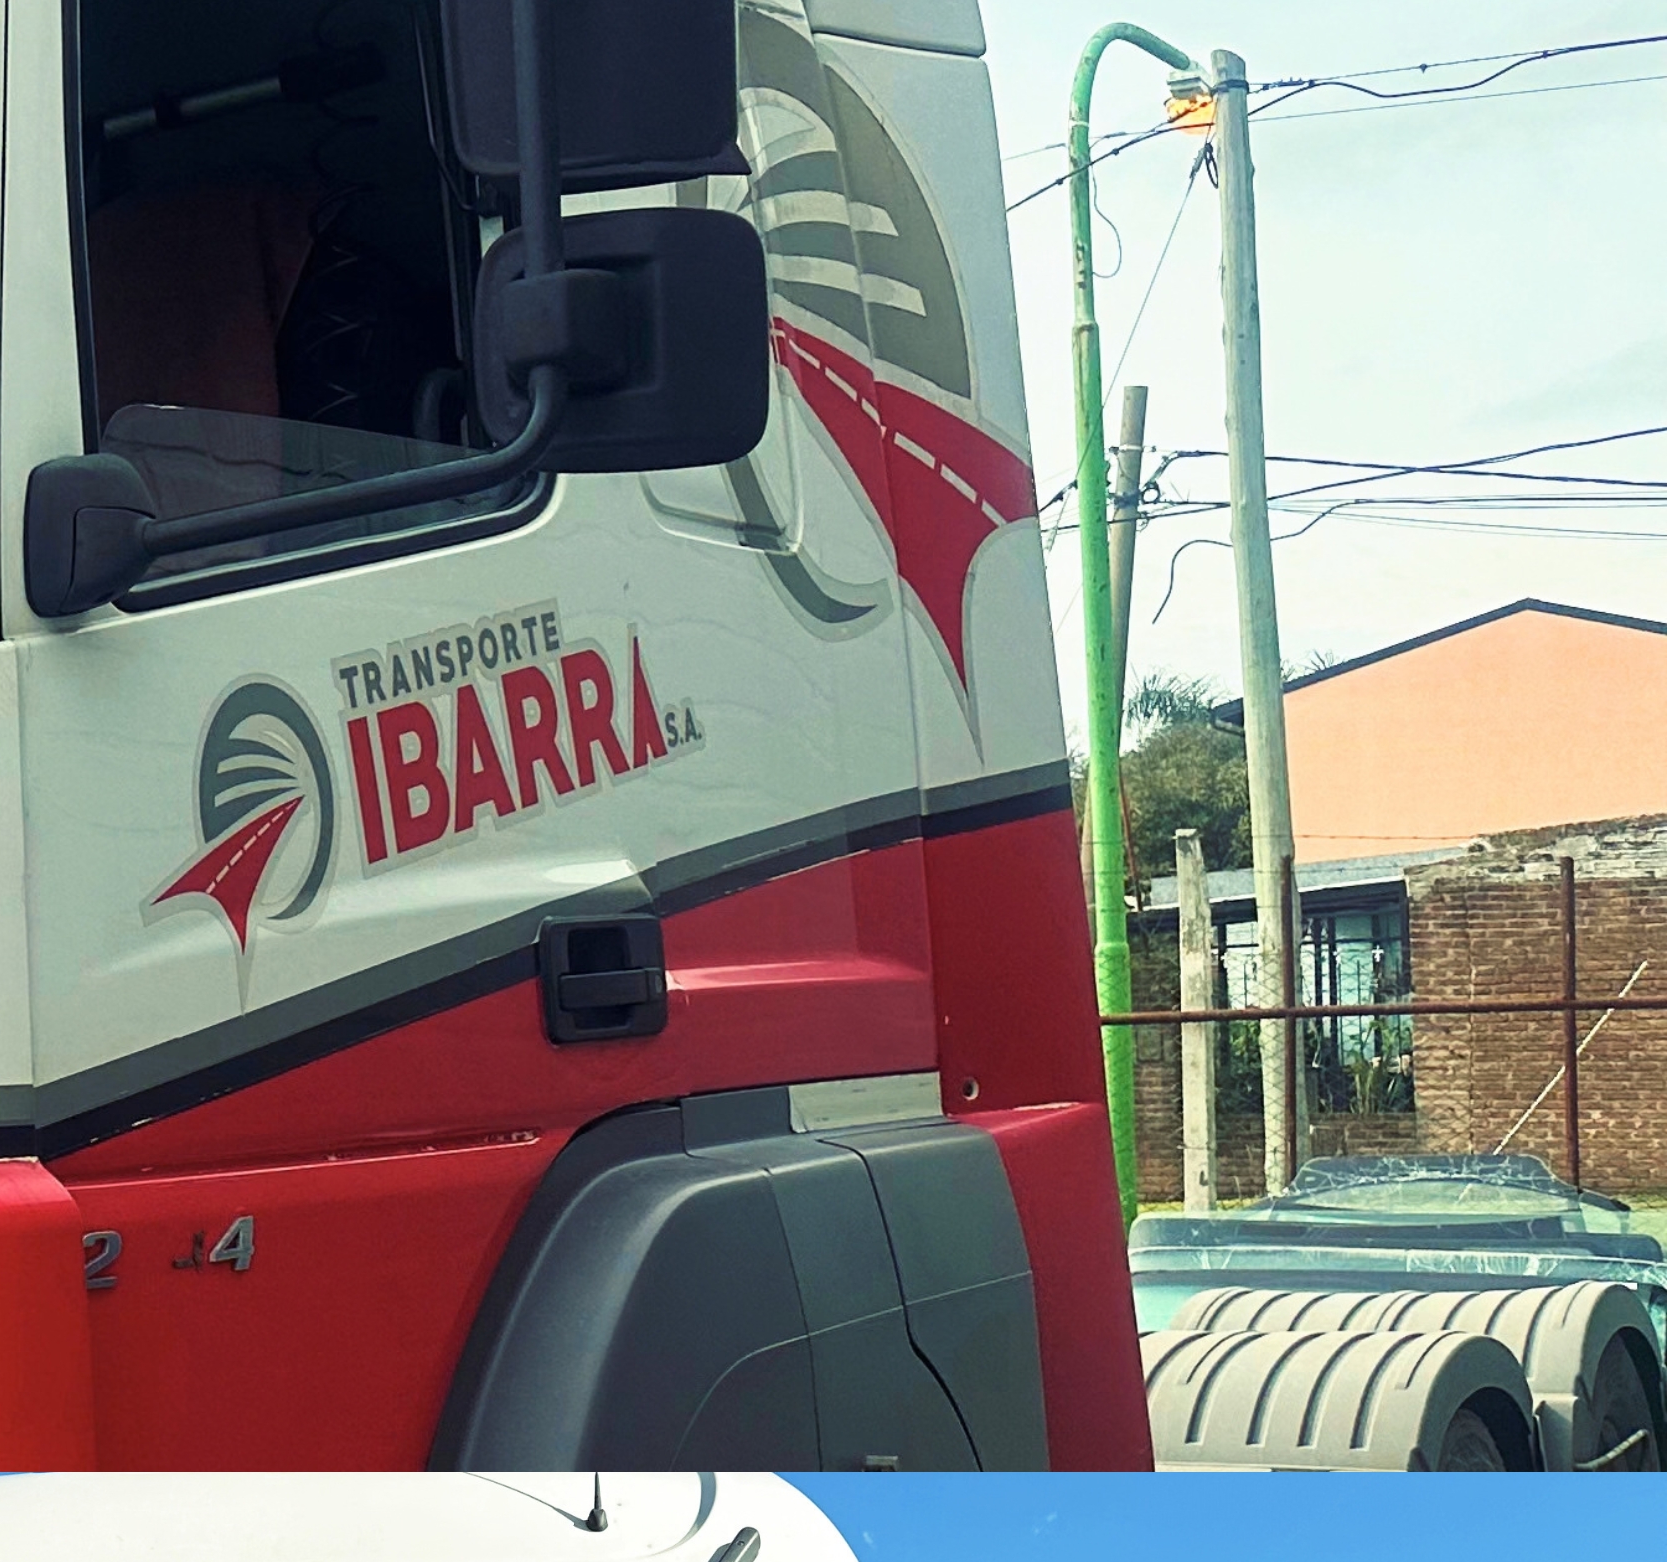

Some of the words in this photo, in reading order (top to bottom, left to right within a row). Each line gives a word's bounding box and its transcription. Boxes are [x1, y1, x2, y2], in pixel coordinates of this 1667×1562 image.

[339, 612, 561, 708] TRANSPORTE
[347, 636, 668, 864] IBARRA
[664, 707, 702, 748] S.A.
